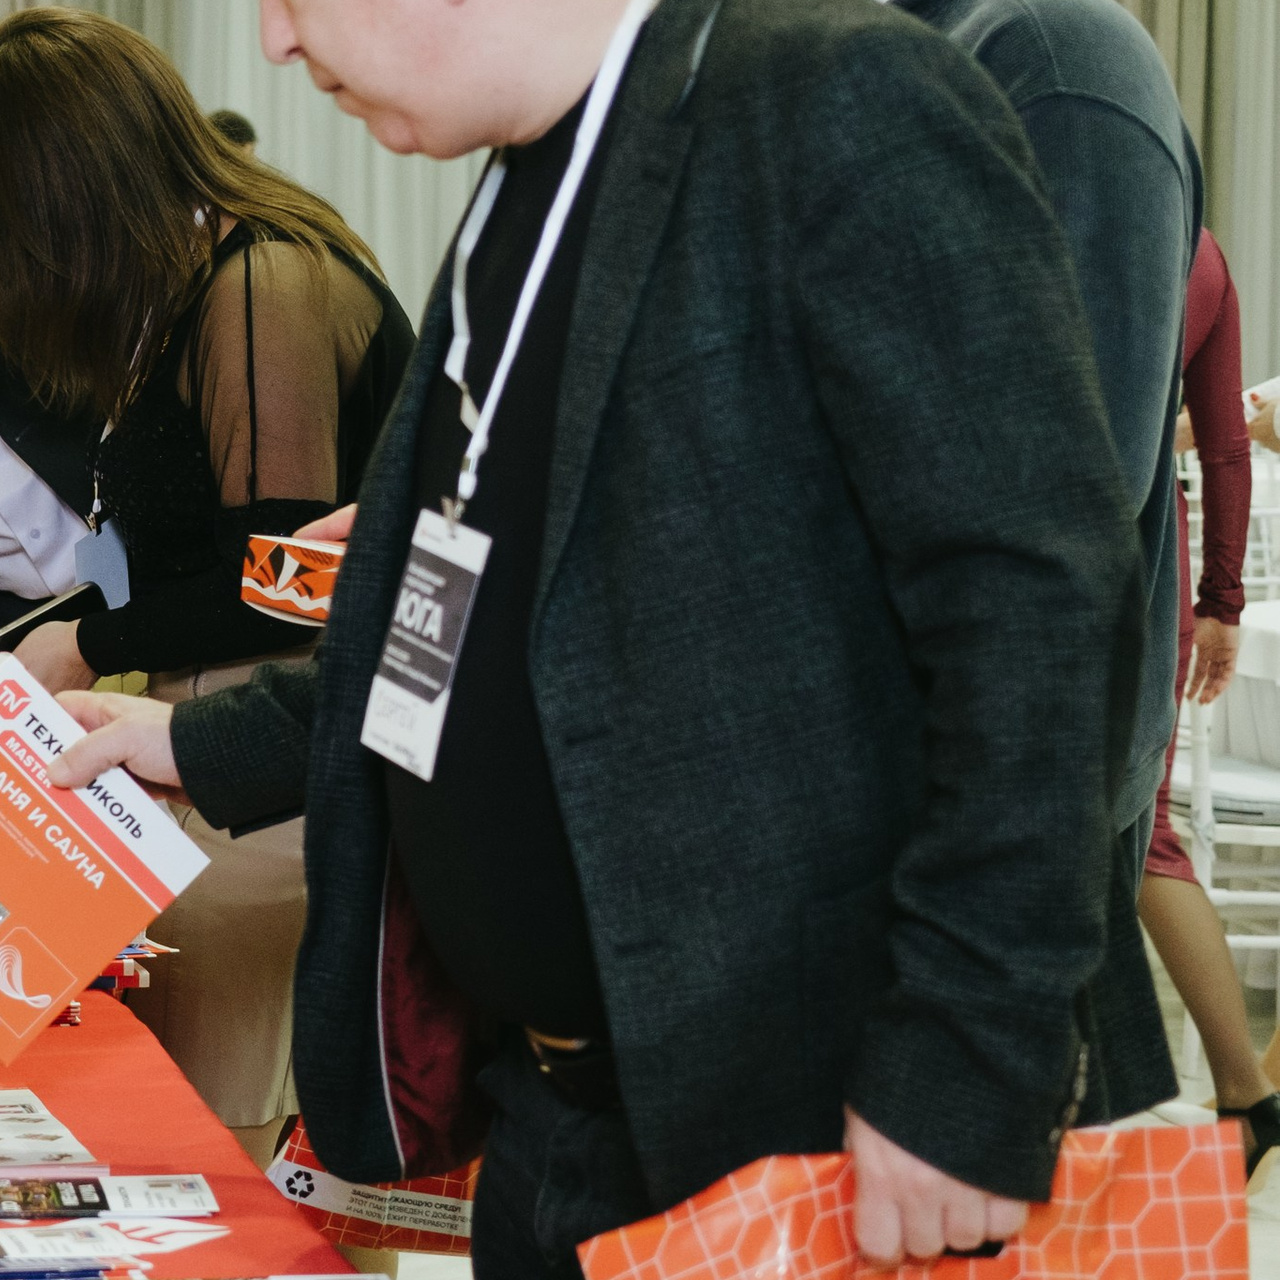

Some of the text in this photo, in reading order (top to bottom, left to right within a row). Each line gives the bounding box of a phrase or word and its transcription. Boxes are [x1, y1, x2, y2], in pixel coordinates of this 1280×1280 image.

[394, 589, 444, 643] ЮГА
[24, 713, 142, 839] ТЕХНИКОЛЬ
[27, 807, 48, 828] И
[45, 825, 105, 890] САУНА
[351, 1189, 387, 1203] ЗАЩИТИТ
